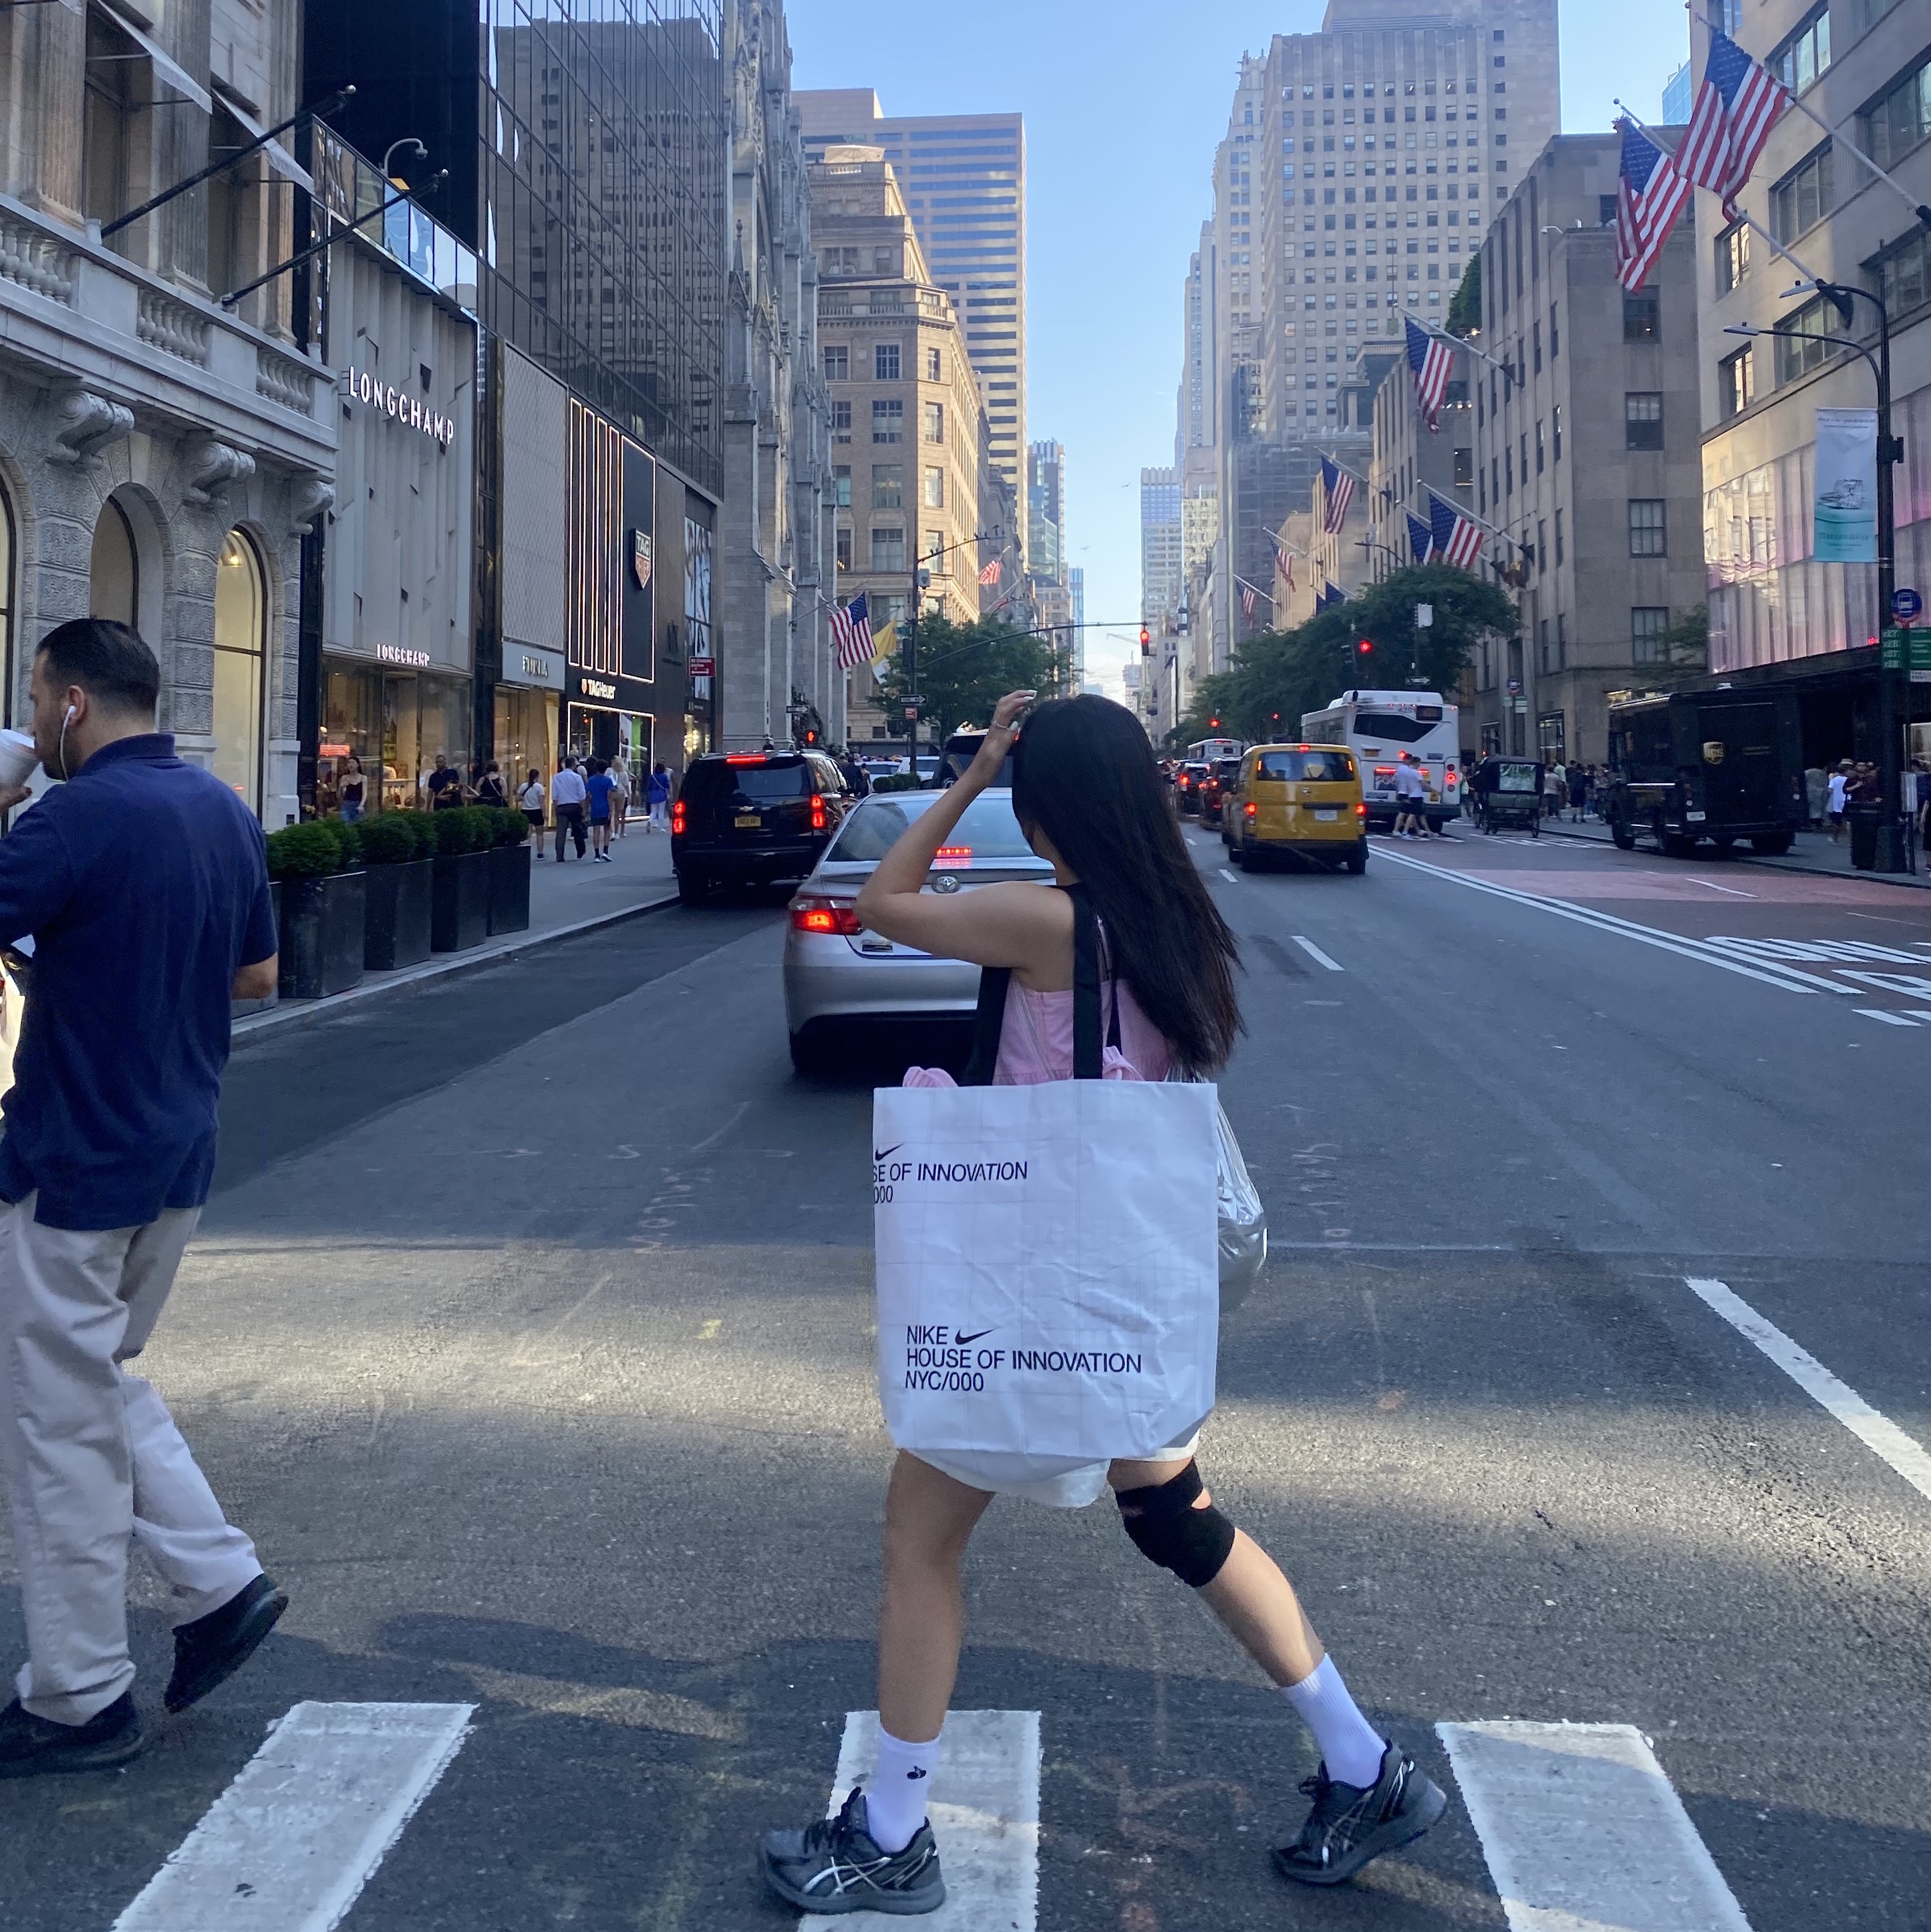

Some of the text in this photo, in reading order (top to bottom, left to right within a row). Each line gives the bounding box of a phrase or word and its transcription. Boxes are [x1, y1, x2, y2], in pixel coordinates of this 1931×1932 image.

[349, 366, 454, 445] LONGCHAMP
[636, 535, 649, 557] TAG
[523, 655, 549, 678] FURLA
[889, 1163, 913, 1182] OF
[917, 1161, 1028, 1182] INNOVATION
[907, 1325, 949, 1345] NIKE
[907, 1348, 1142, 1374] HOUSE OF INNOVATION
[905, 1370, 984, 1392] NYC/000
